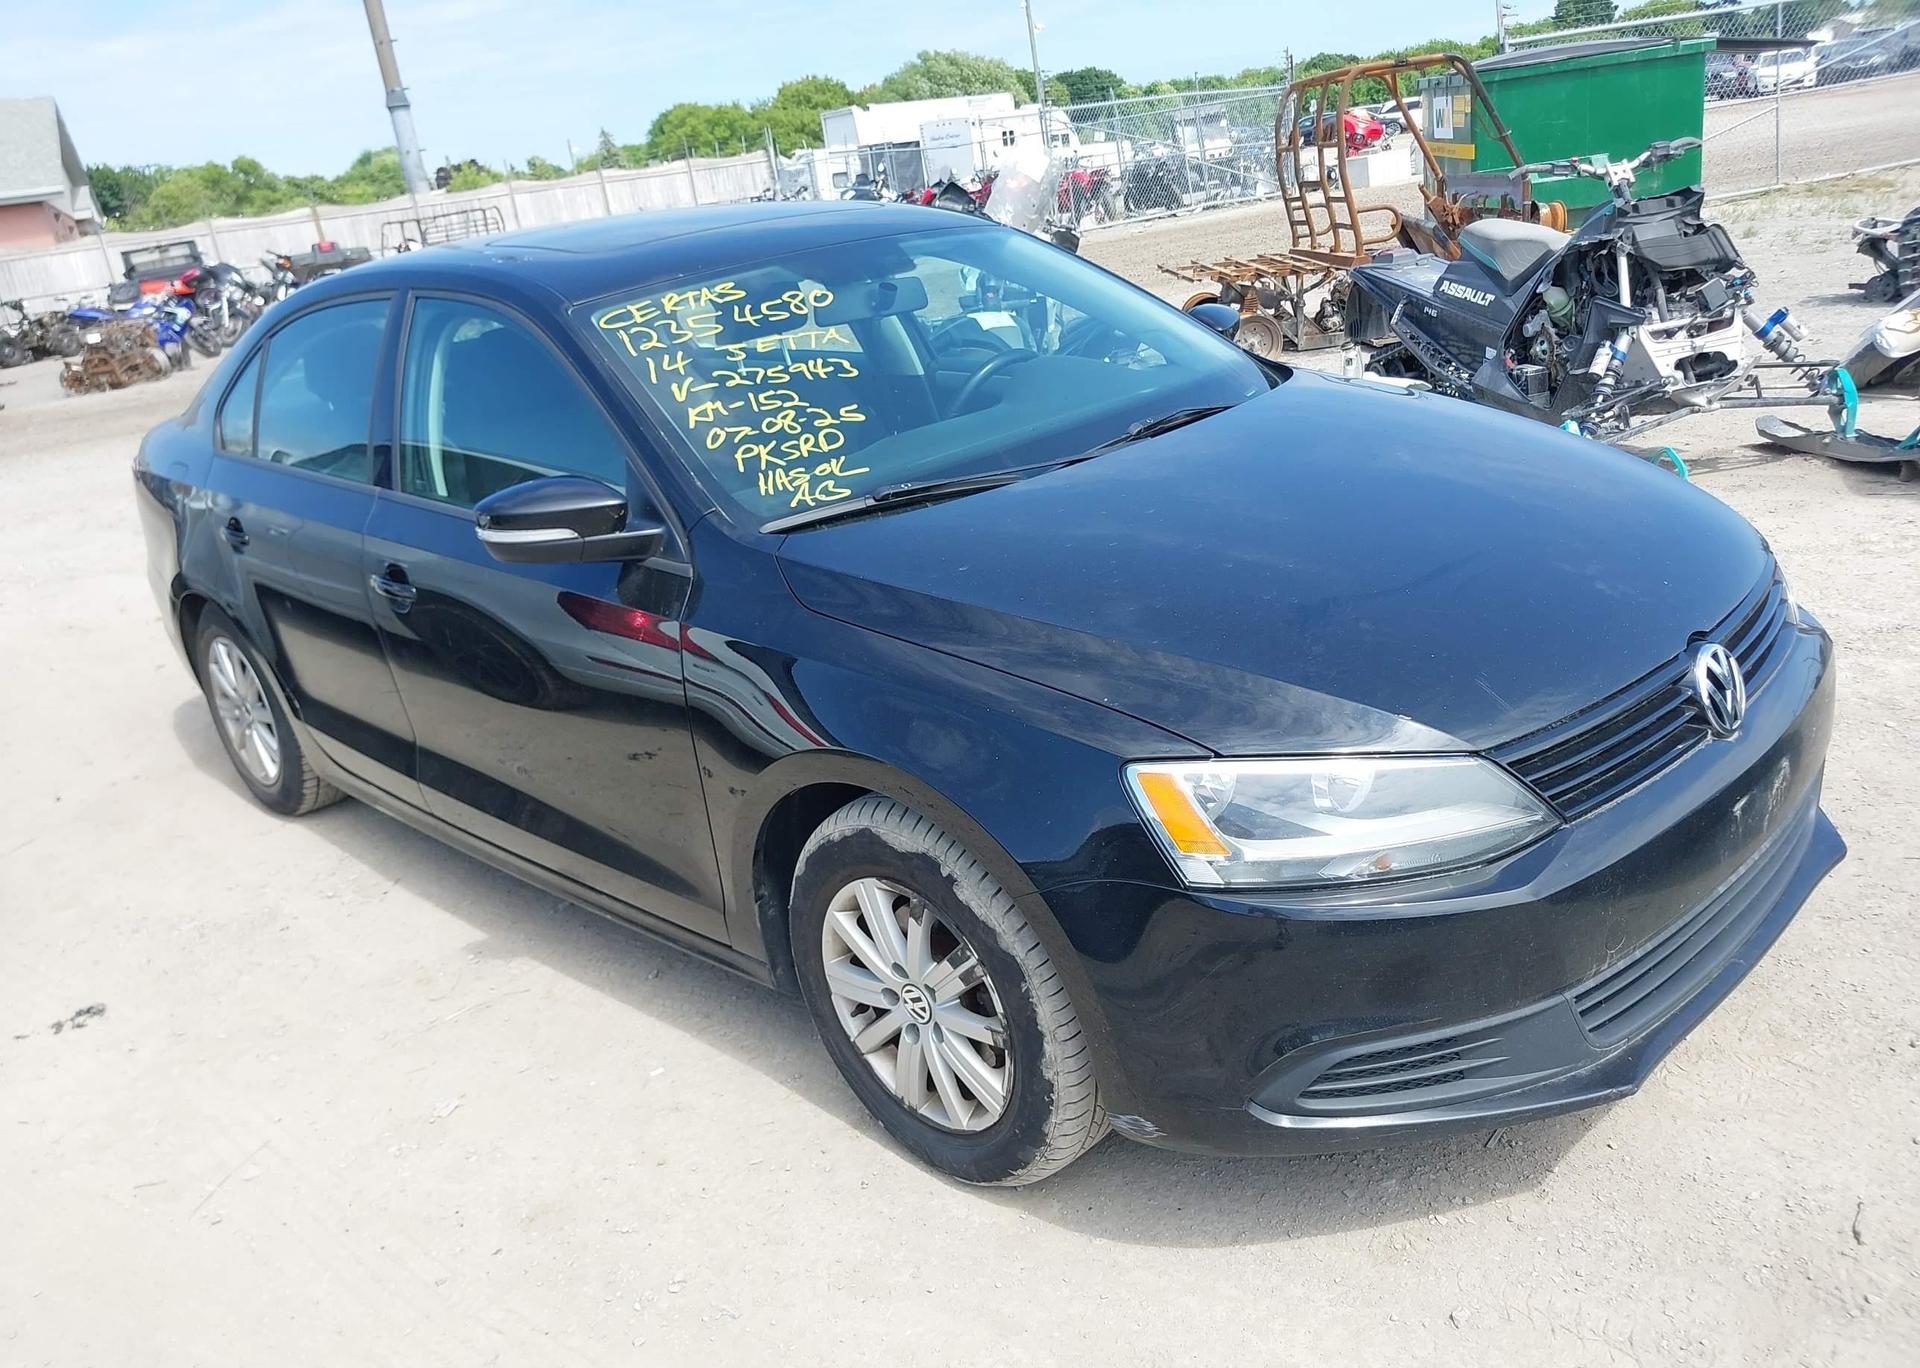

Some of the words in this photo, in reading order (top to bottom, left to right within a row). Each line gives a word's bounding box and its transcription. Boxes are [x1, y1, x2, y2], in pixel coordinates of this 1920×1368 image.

[599, 281, 747, 330] CERTAS
[1439, 280, 1496, 307] ASSAULT
[646, 350, 693, 384] 14
[714, 328, 850, 361] JETTA
